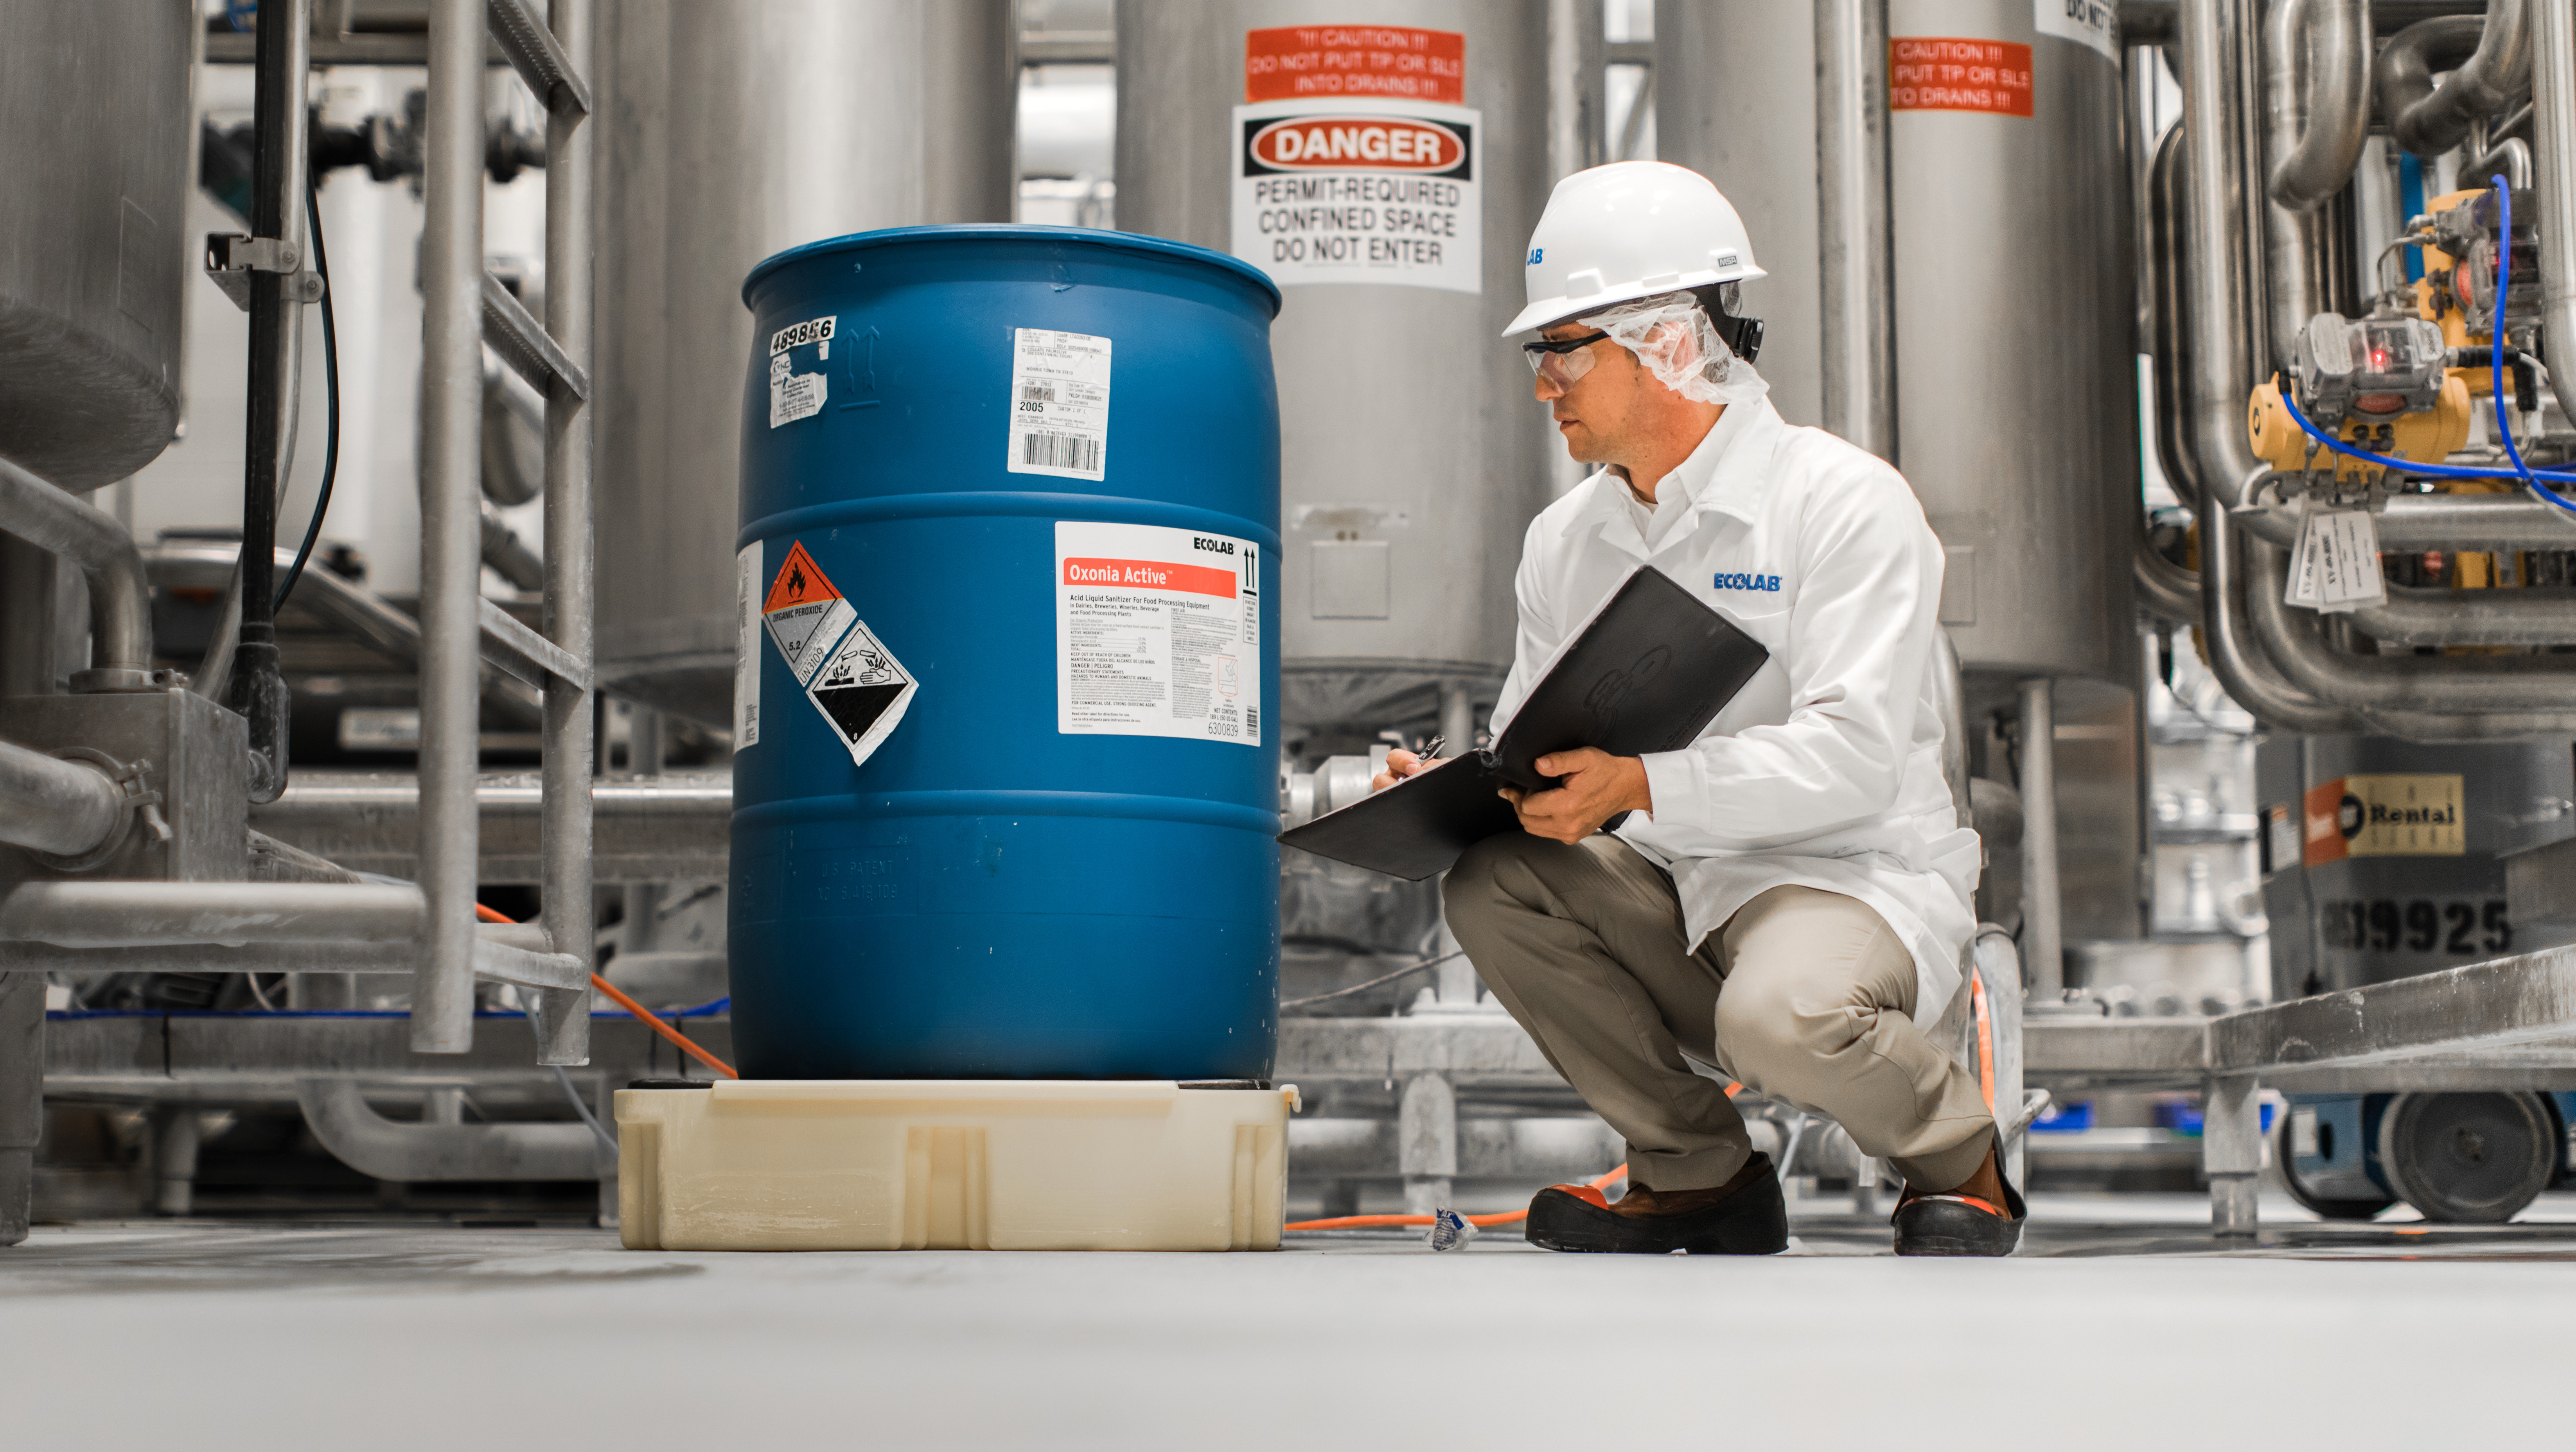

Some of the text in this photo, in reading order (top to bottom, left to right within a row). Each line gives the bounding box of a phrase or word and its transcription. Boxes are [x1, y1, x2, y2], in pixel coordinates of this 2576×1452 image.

[1320, 29, 1408, 47] CAUTION
[1895, 41, 1984, 61] CAUTION
[1248, 54, 1278, 75] DO
[1279, 52, 1320, 70] NOT
[1324, 51, 1364, 69] PUT
[1396, 53, 1426, 72] OR
[1295, 74, 1343, 92] INTO
[1345, 73, 1418, 94] DRAINS
[1895, 65, 1933, 83] PUT
[1967, 66, 1996, 84] OR
[1919, 87, 1991, 107] DRAINS
[1275, 127, 1441, 164] DANGER
[1256, 178, 1460, 207] PERMIT-REQUIRED
[1259, 207, 1457, 237] CONFINED SPACE
[1274, 237, 1442, 265] DO NOT ENTER
[1719, 256, 1737, 266] MSA
[1020, 402, 1043, 412] 2005
[1194, 537, 1234, 555] ECOLAB
[1070, 565, 1119, 582] Oxonia
[1714, 573, 1780, 591] ECOLAB
[773, 604, 823, 622] ORGANIC PEROXIDE
[1159, 598, 1185, 608] Processing
[1187, 601, 1209, 610] Equipment
[789, 641, 801, 651] 5.2
[800, 646, 825, 684] UN3109
[853, 732, 858, 741] 8
[1209, 722, 1238, 737] 6300839
[2370, 804, 2454, 824] Rental
[850, 860, 894, 876] PATENT
